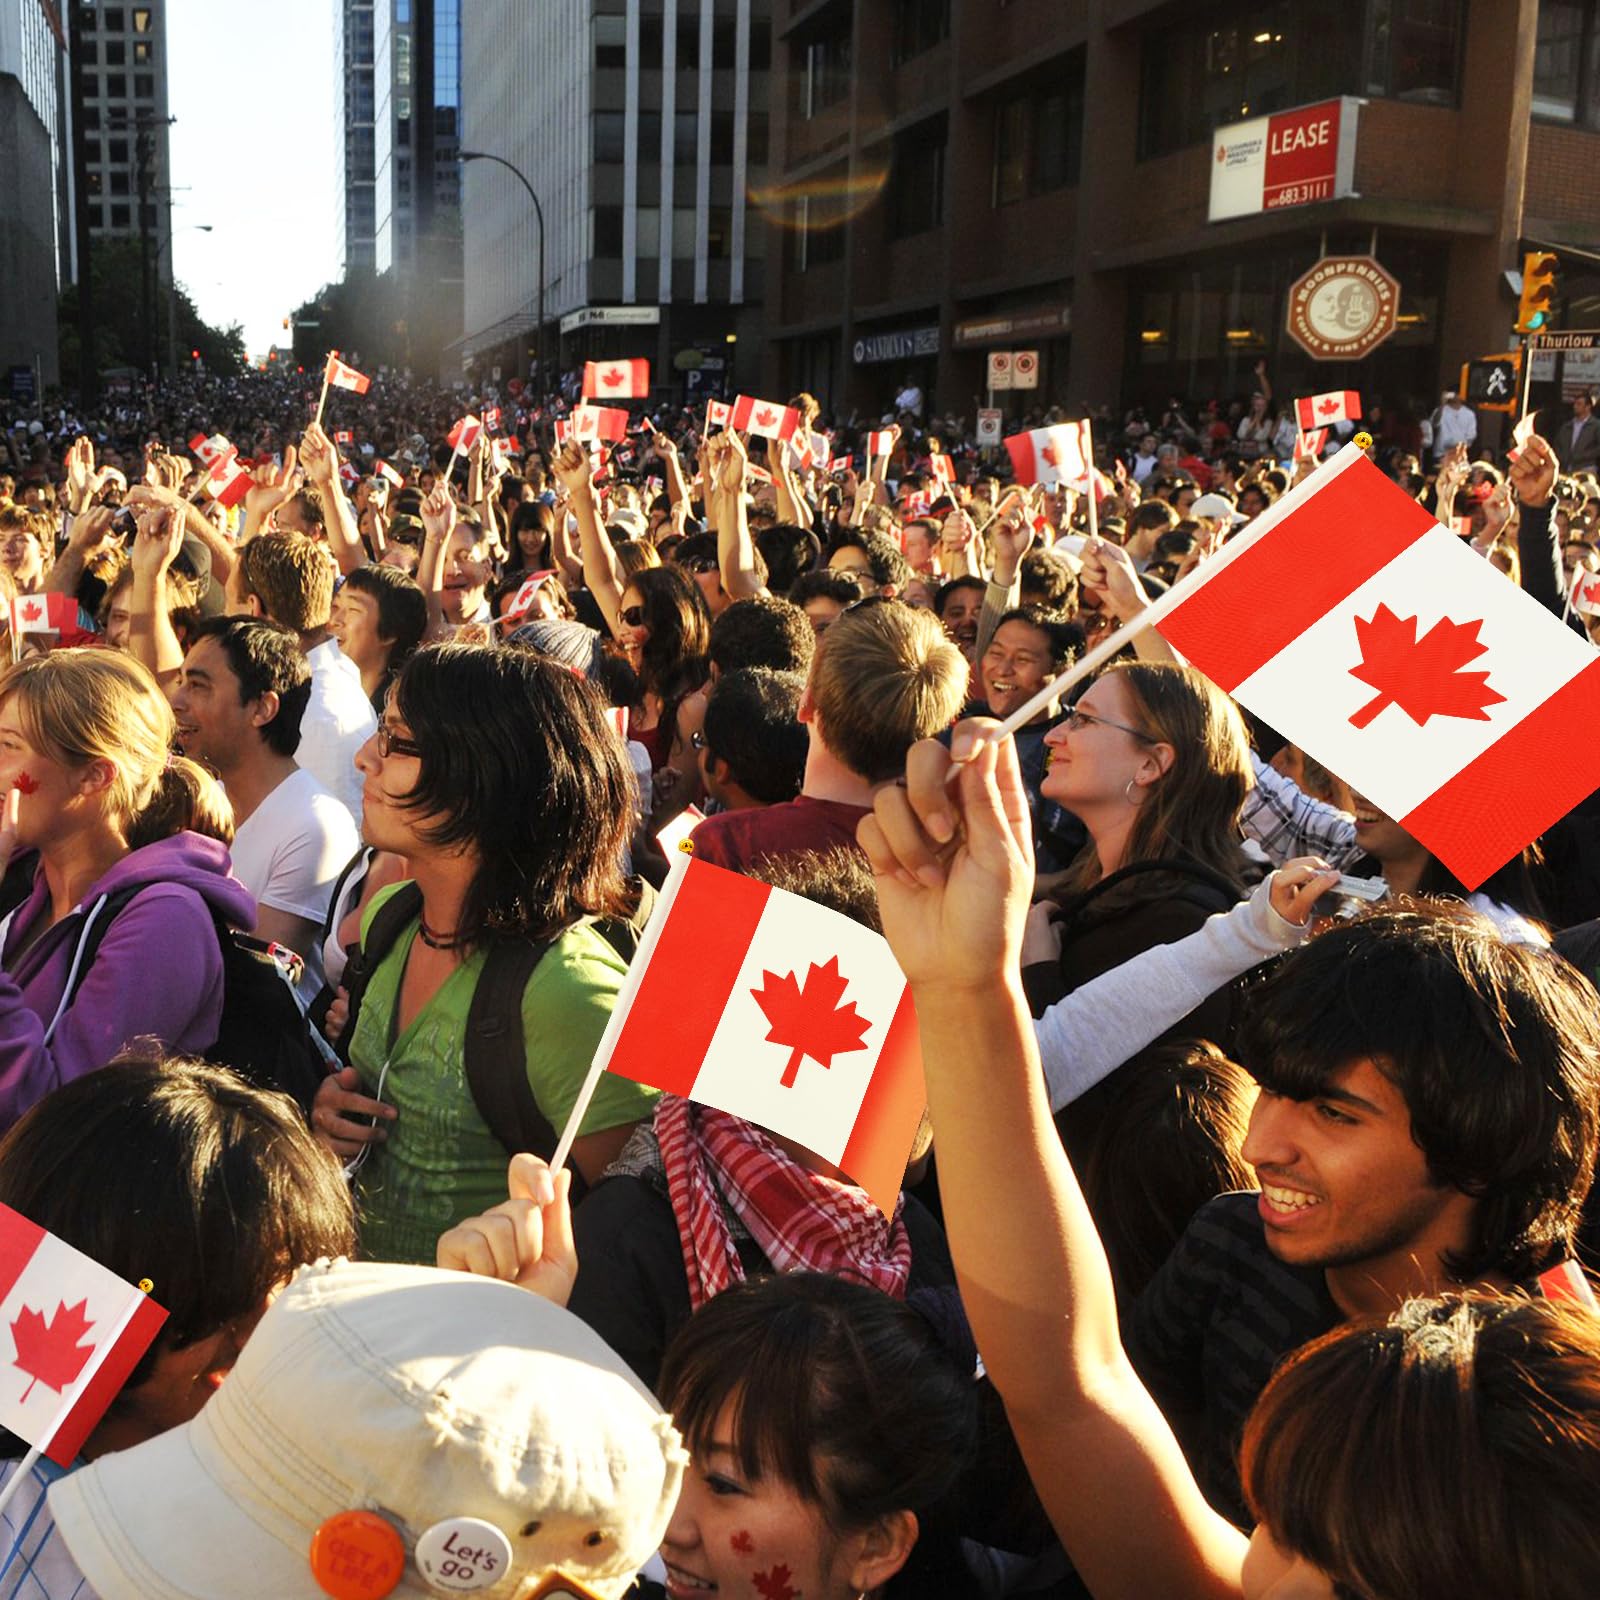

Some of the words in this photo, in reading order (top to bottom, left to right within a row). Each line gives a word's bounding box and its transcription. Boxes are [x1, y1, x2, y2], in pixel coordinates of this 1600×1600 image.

[1271, 120, 1330, 156] LEASE
[1297, 263, 1391, 302] MOONPENNIES
[1541, 334, 1593, 348] Thurlow
[443, 1531, 498, 1571] Let's
[440, 1560, 474, 1580] go
